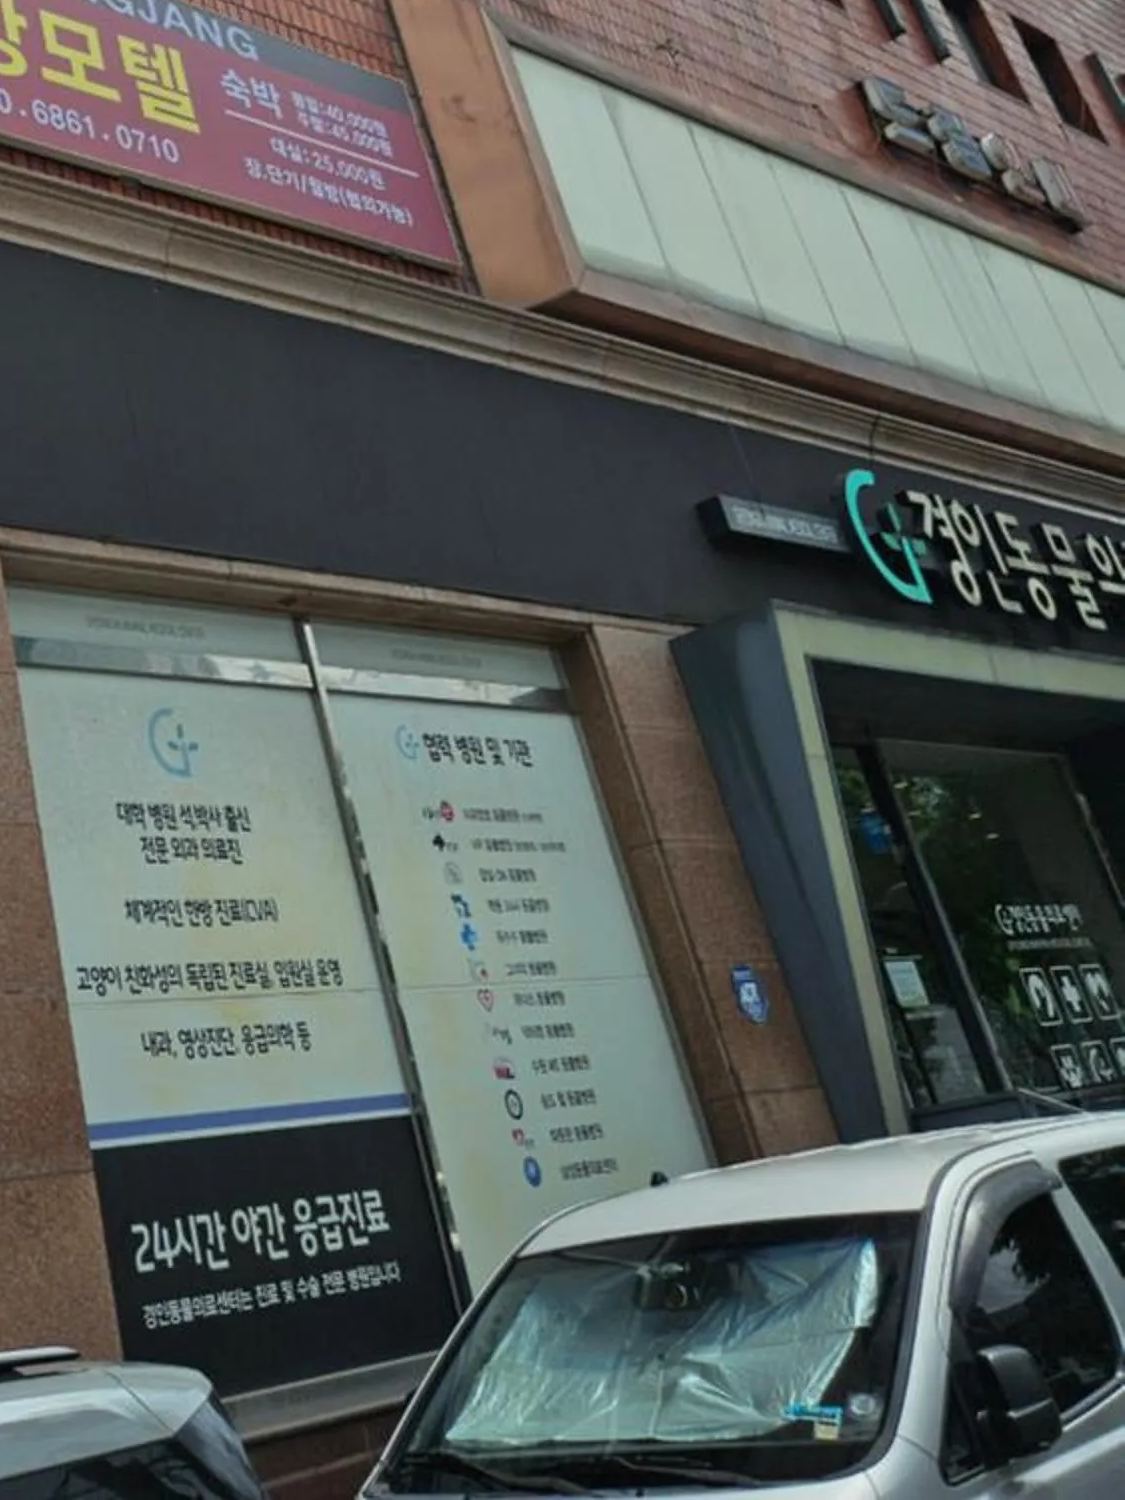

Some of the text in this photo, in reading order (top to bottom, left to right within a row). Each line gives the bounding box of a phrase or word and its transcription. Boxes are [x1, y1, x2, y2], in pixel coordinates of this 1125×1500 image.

[220, 68, 283, 119] 숙박
[906, 489, 1125, 631] 경인동물의
[139, 836, 169, 864] 전문
[76, 964, 123, 997] 고양이
[316, 958, 343, 987] 운영
[241, 1024, 296, 1056] 응급의학
[296, 1021, 311, 1052] 등
[131, 1189, 390, 1274] 24시간 야간 응급진료
